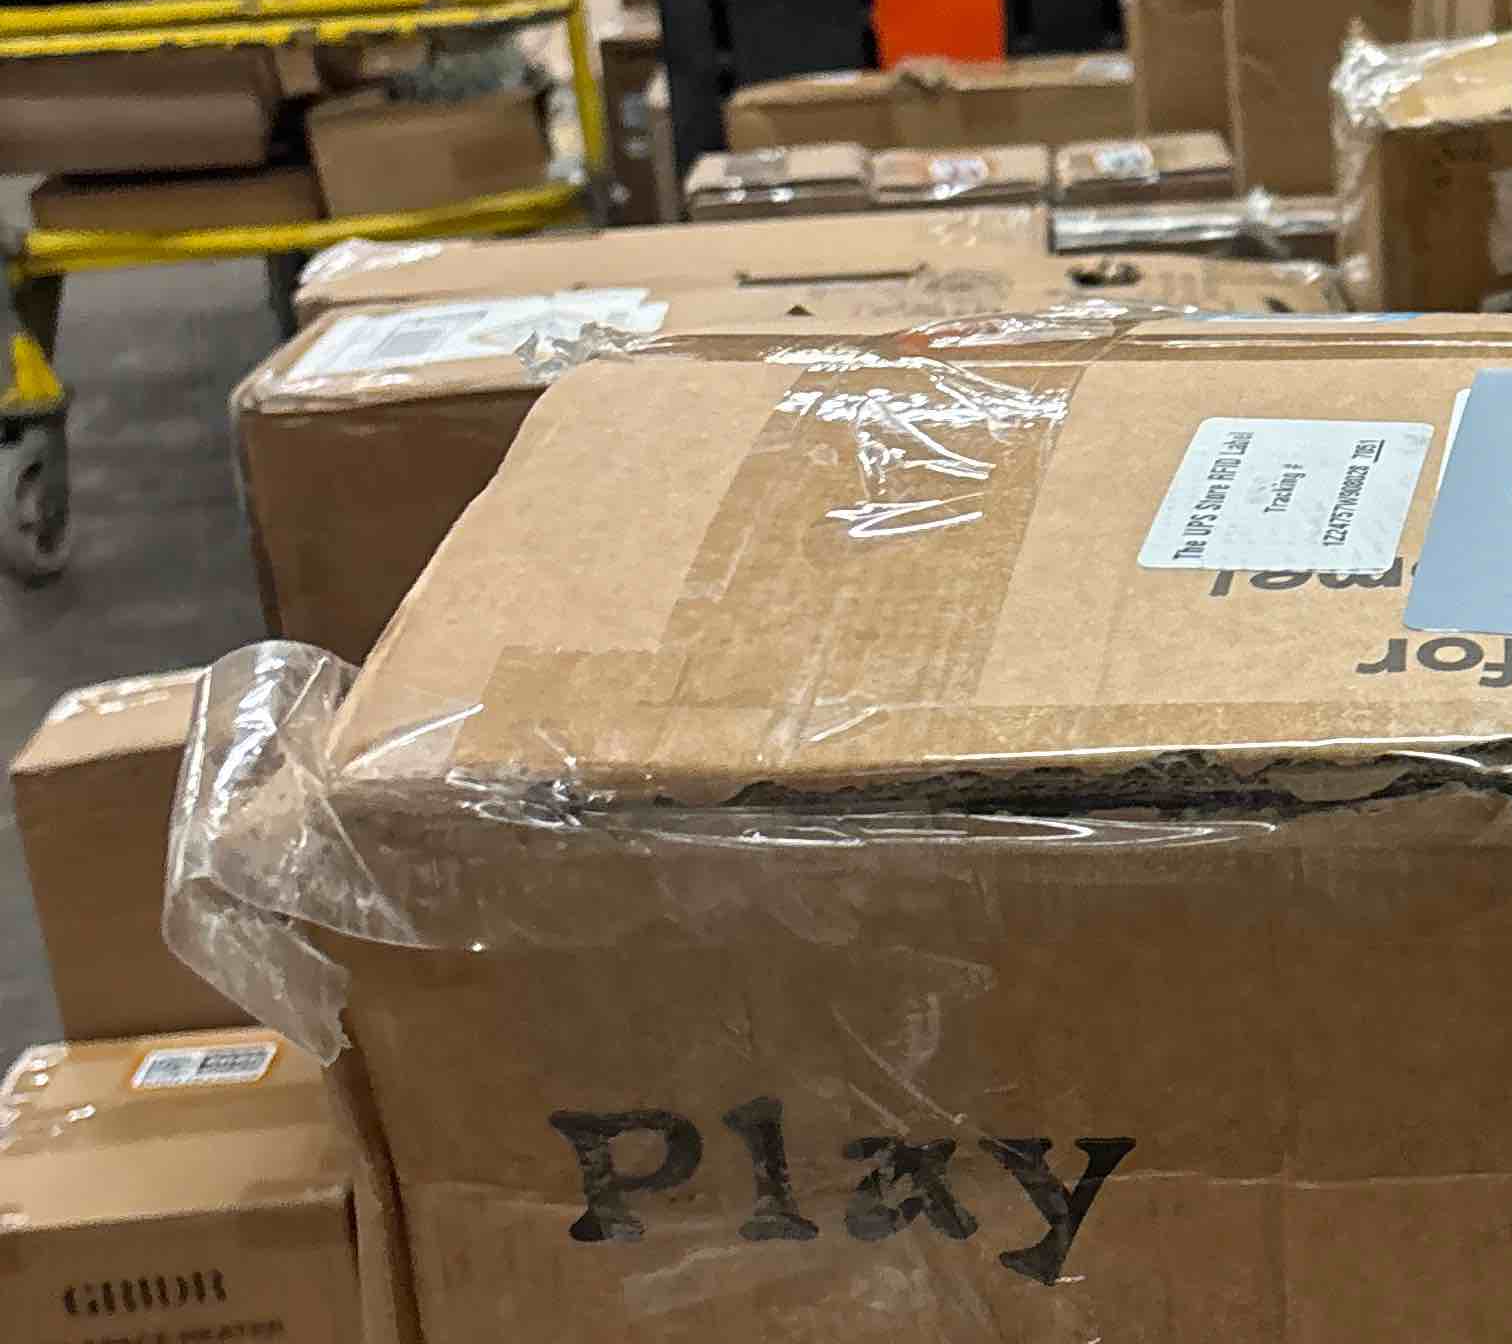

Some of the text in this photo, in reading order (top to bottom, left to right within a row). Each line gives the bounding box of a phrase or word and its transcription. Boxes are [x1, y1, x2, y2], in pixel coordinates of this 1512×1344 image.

[1173, 431, 1255, 560] The UPS Store RFID Label
[1264, 469, 1307, 514] Tracking
[549, 1096, 1136, 1285] Play
